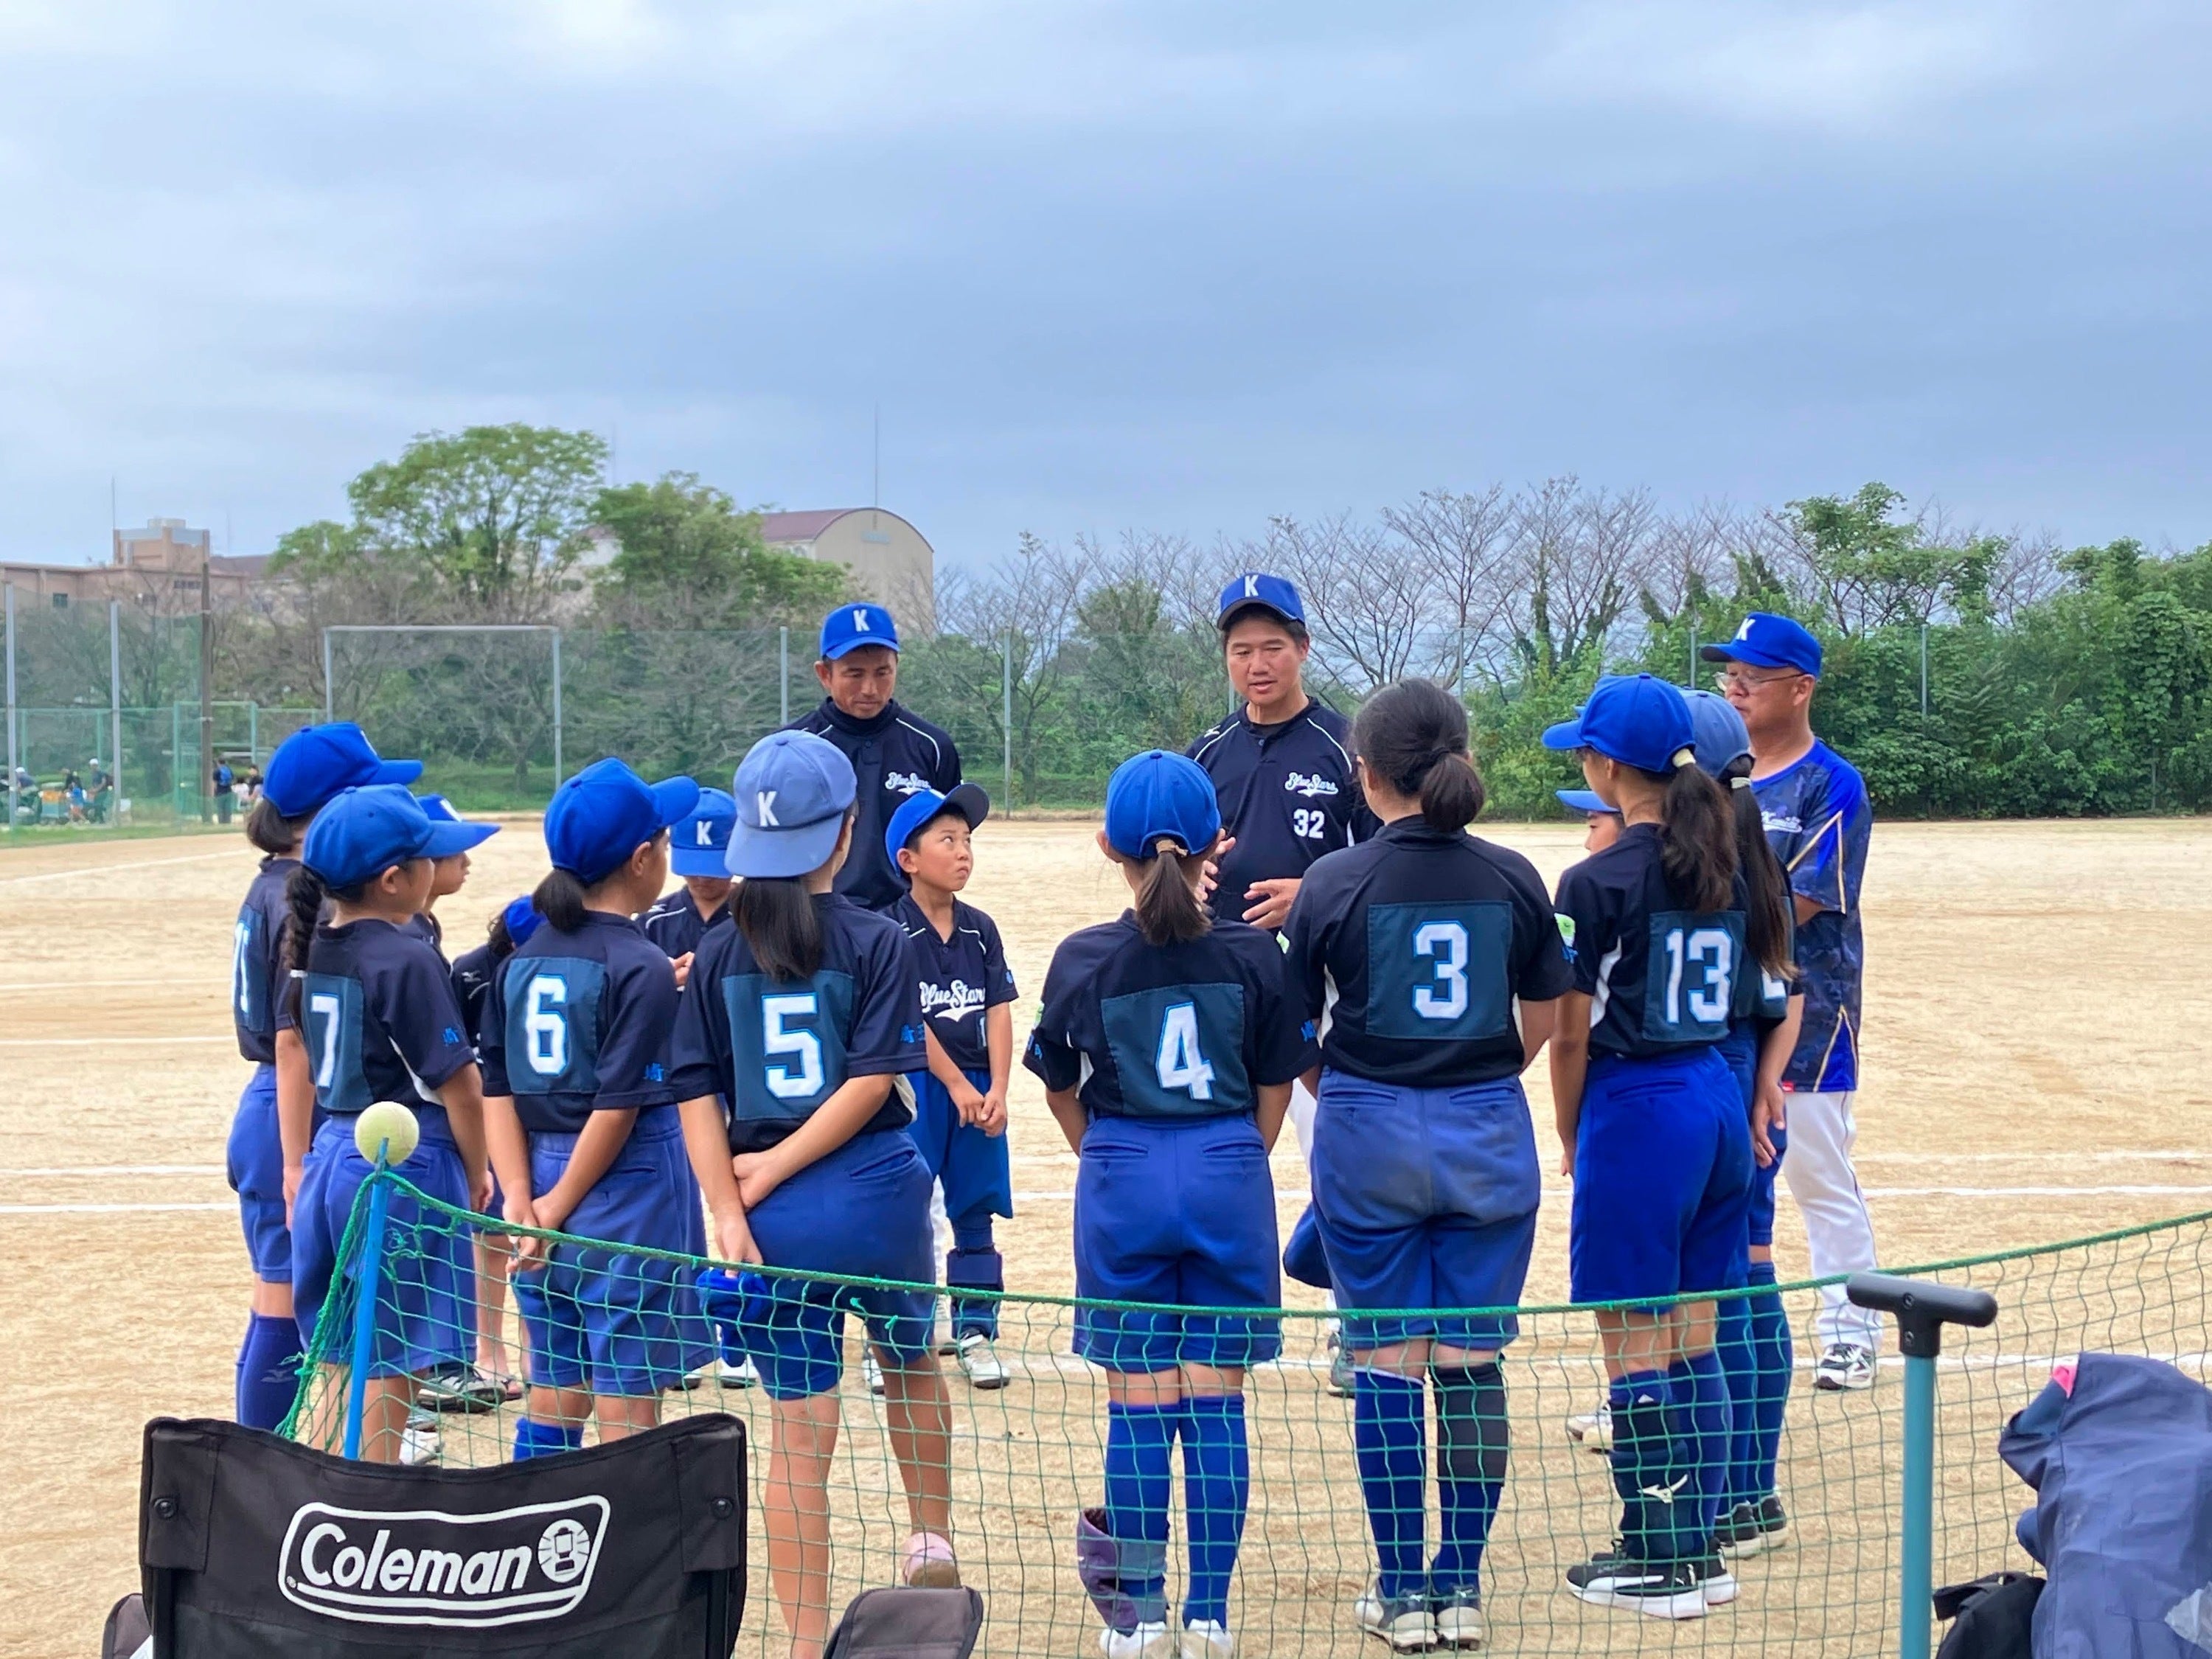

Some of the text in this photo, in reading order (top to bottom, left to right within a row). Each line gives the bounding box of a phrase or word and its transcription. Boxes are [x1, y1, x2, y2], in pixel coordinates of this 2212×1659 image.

[853, 609, 869, 631] K
[1245, 574, 1259, 597] K
[1736, 618, 1756, 641] K
[697, 821, 712, 846] K
[757, 791, 779, 827] K
[1293, 808, 1325, 839] 32
[1413, 920, 1470, 1020] 3
[1666, 928, 1733, 1023] 13
[310, 992, 340, 1089] 7
[524, 973, 568, 1076] 6
[762, 992, 825, 1099] 5
[1155, 1001, 1216, 1101] 4
[299, 1522, 533, 1596] Coleman
